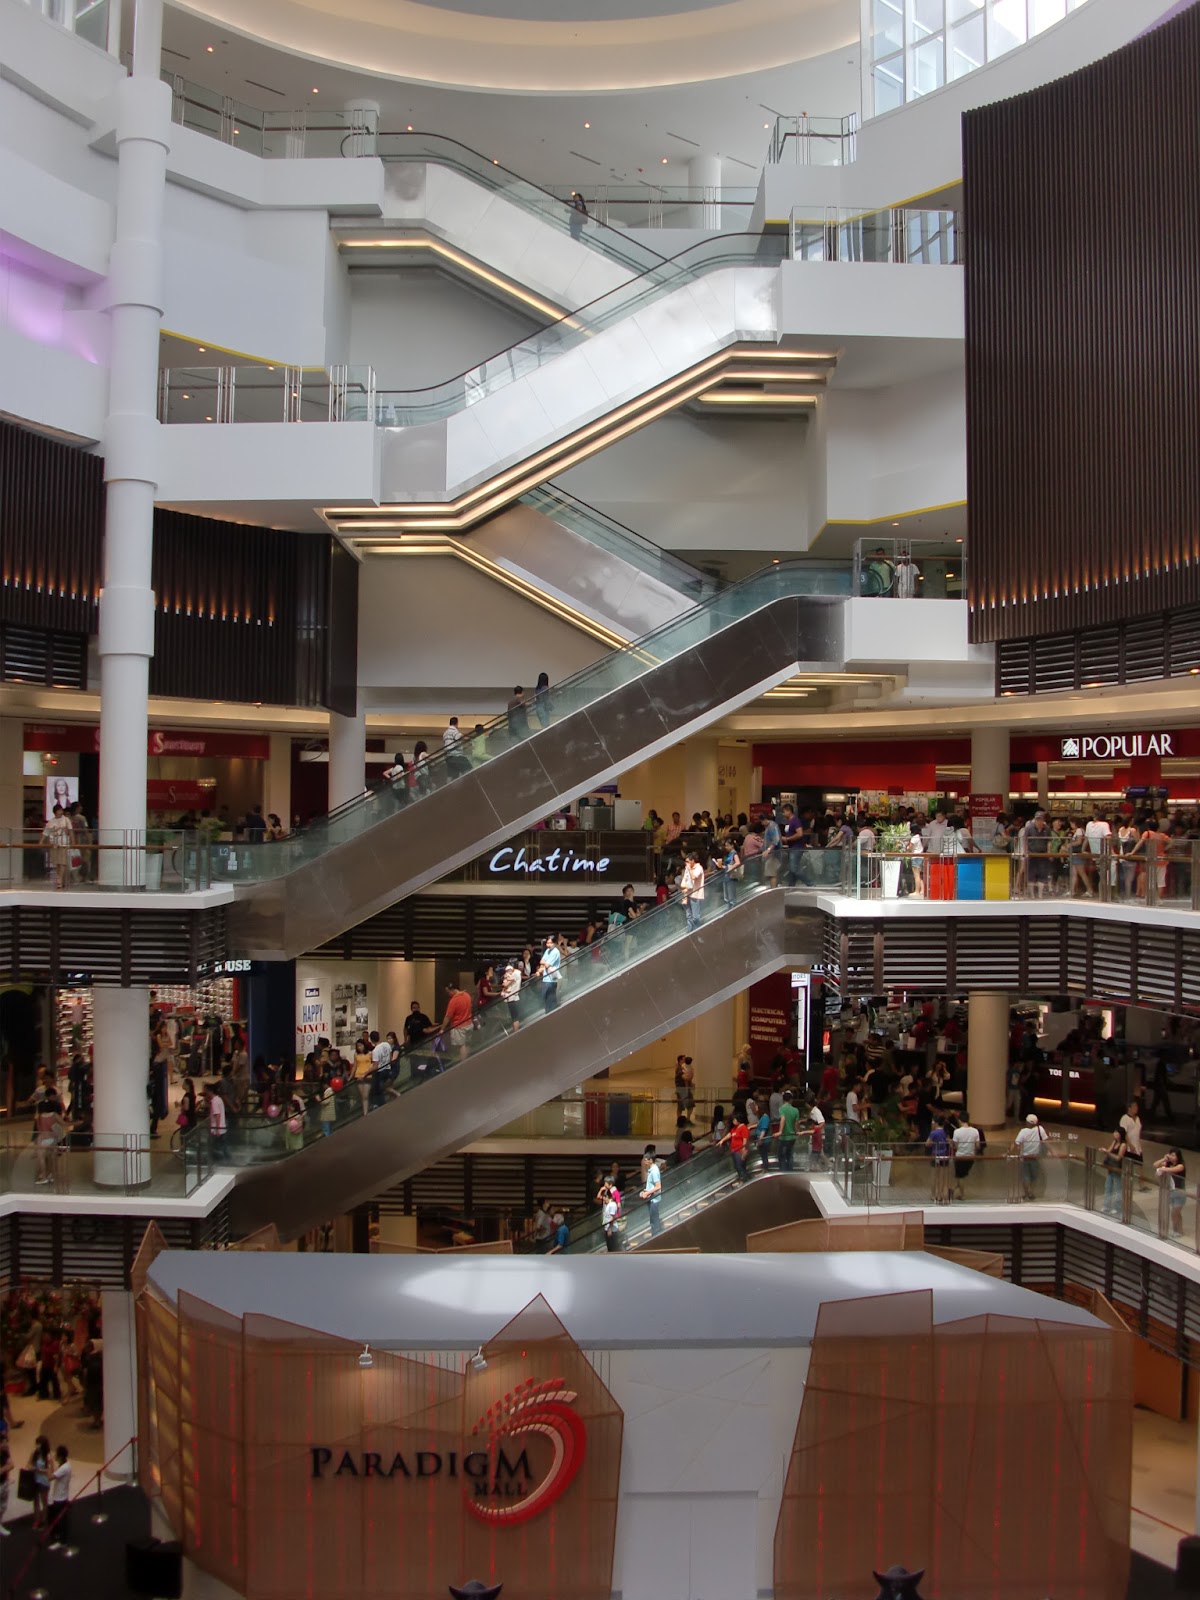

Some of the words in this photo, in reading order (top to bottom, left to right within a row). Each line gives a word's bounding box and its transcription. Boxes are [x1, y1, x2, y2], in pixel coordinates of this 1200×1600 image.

[1082, 733, 1174, 758] POPULAR
[219, 848, 229, 856] L2
[489, 847, 610, 872] Chatime
[214, 960, 252, 972] USE
[303, 1004, 323, 1023] HAPPY
[751, 1007, 784, 1016] ELECTRICAL
[751, 1016, 787, 1025] COMPUTERS
[296, 1022, 328, 1034] SINCE
[1048, 1068, 1080, 1078] TOSBA
[310, 1447, 532, 1480] PARADIGM
[474, 1483, 528, 1497] MALL
